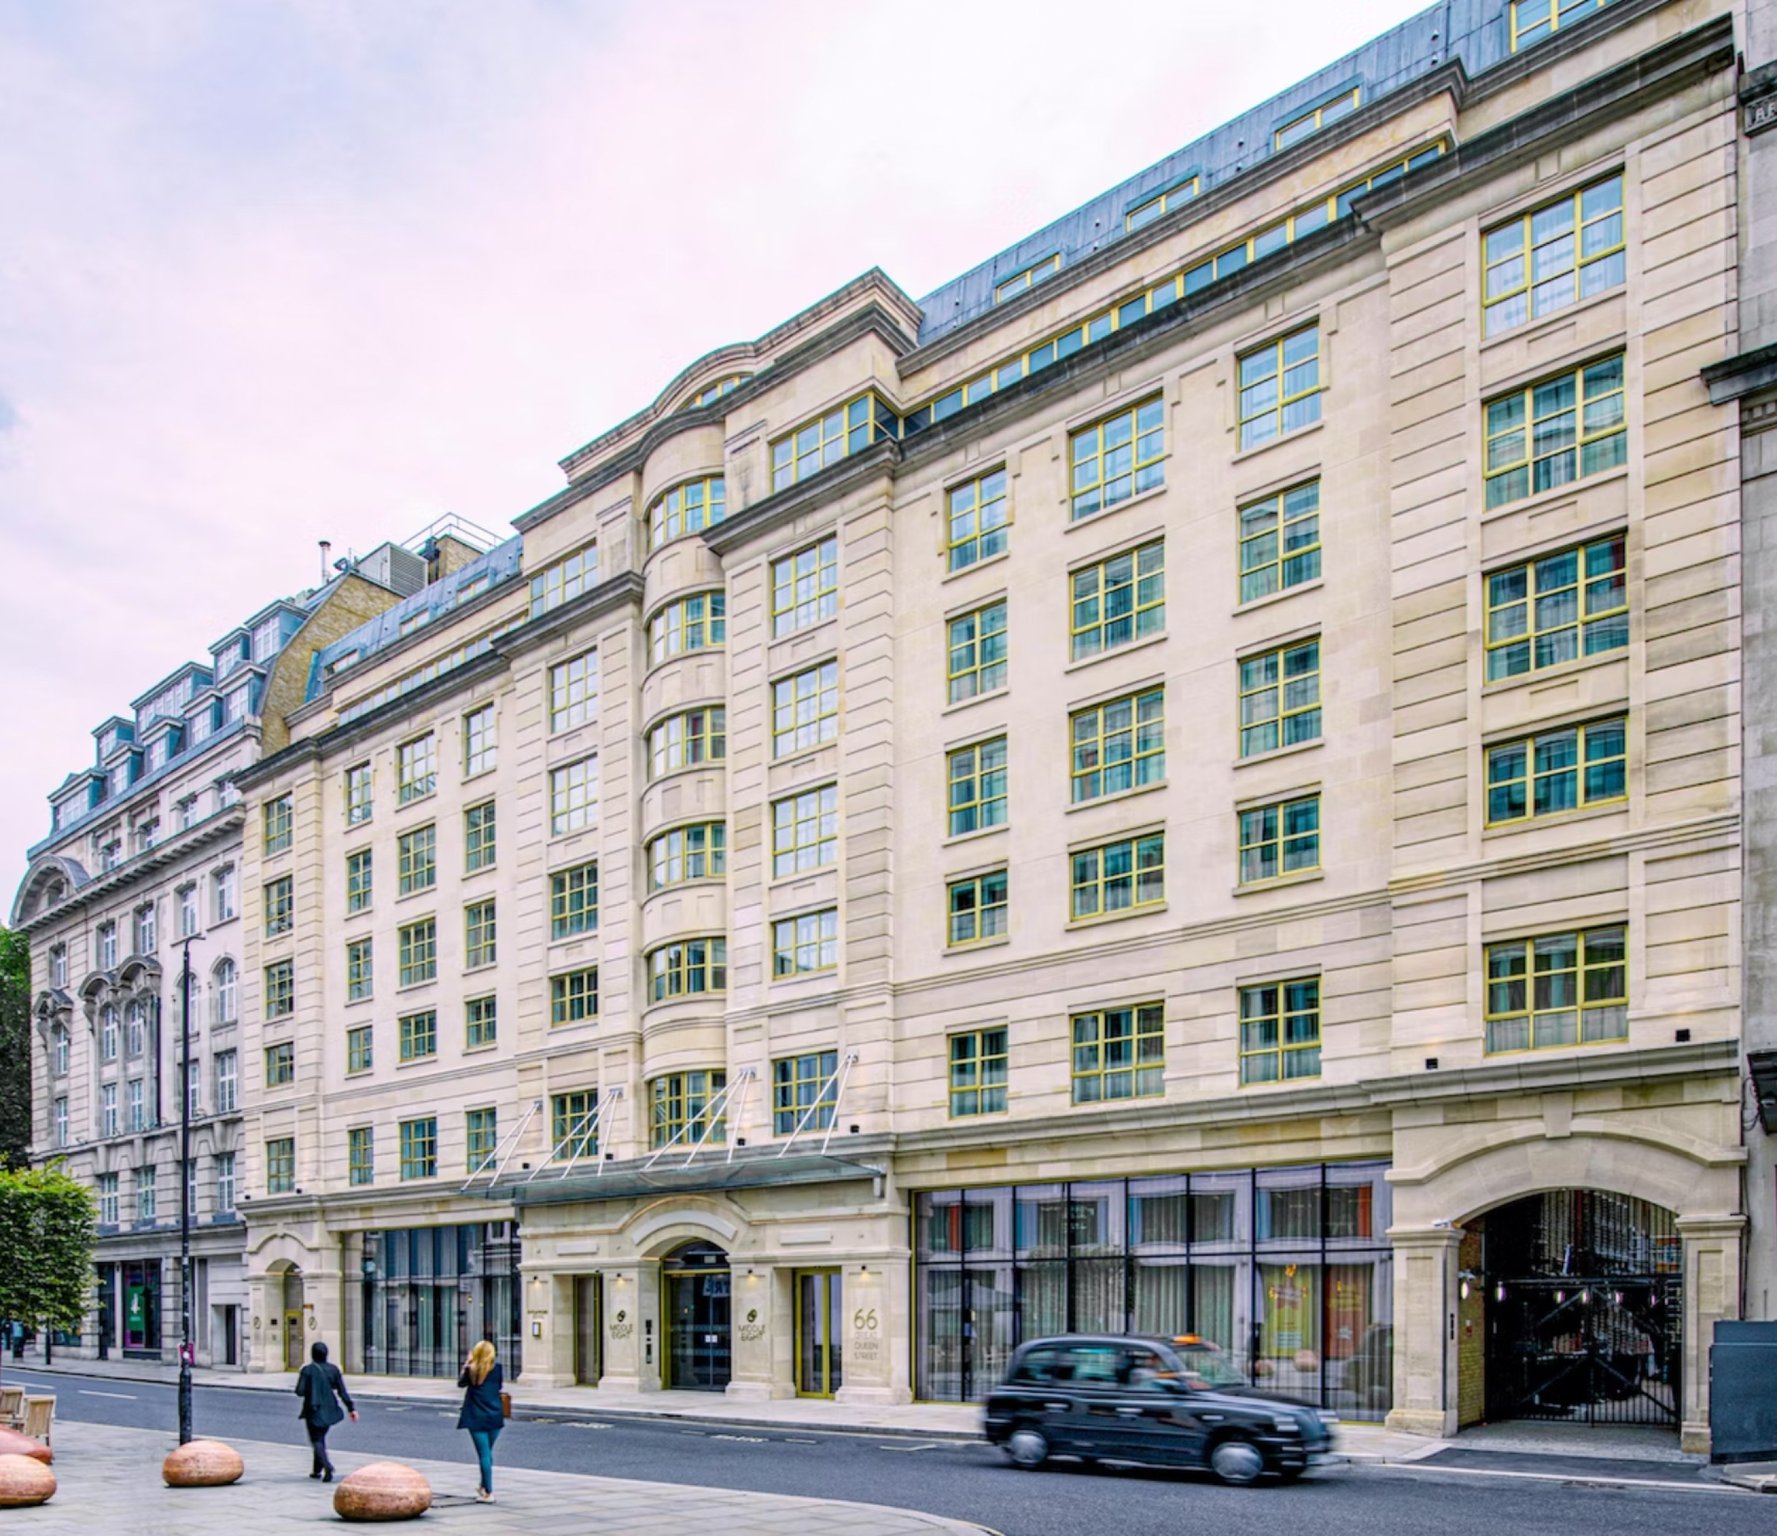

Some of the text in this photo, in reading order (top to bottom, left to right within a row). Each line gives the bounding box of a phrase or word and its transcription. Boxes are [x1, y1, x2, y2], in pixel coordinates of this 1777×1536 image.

[854, 1308, 878, 1330] 66
[738, 1324, 765, 1333] MIDDLE
[854, 1341, 878, 1350] QUEEN
